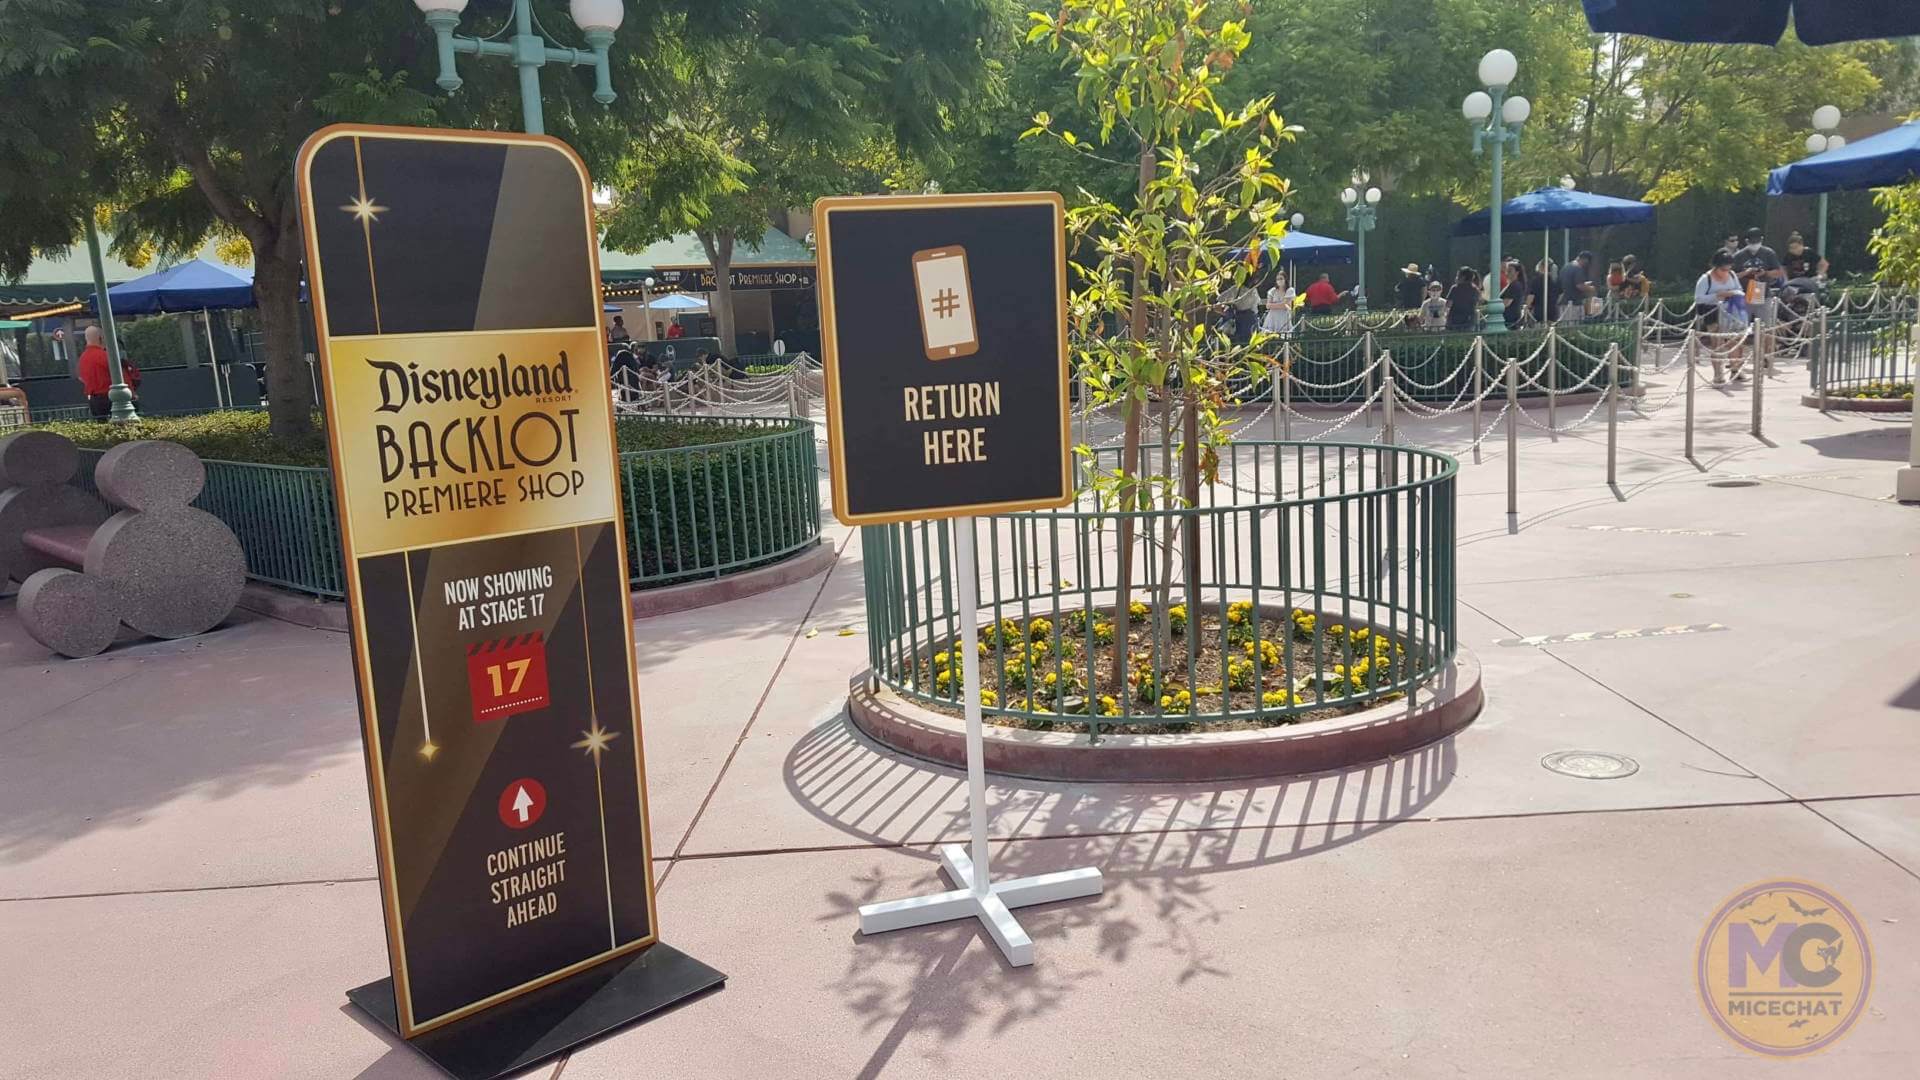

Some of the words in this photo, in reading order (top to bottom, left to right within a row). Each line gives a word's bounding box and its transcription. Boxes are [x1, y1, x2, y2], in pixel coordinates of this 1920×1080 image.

[738, 272, 773, 285] PREMIERE
[774, 271, 797, 284] SHOP
[365, 350, 574, 414] Disneyland
[535, 395, 572, 403] RESORT
[904, 381, 1001, 422] RETURN
[376, 408, 580, 483] BACKLOT
[923, 427, 987, 465] HERE
[384, 478, 507, 519] PREMIERE
[518, 470, 584, 501] SHOP
[444, 577, 479, 605] NOW
[484, 565, 553, 599] SHOWING
[458, 606, 476, 631] AT
[480, 597, 527, 627] STAGE
[529, 593, 545, 617] 17
[487, 657, 532, 697] 17
[487, 832, 566, 876] CONTINUE
[491, 860, 566, 904] STRAIGHT
[507, 892, 557, 928] AHEAD
